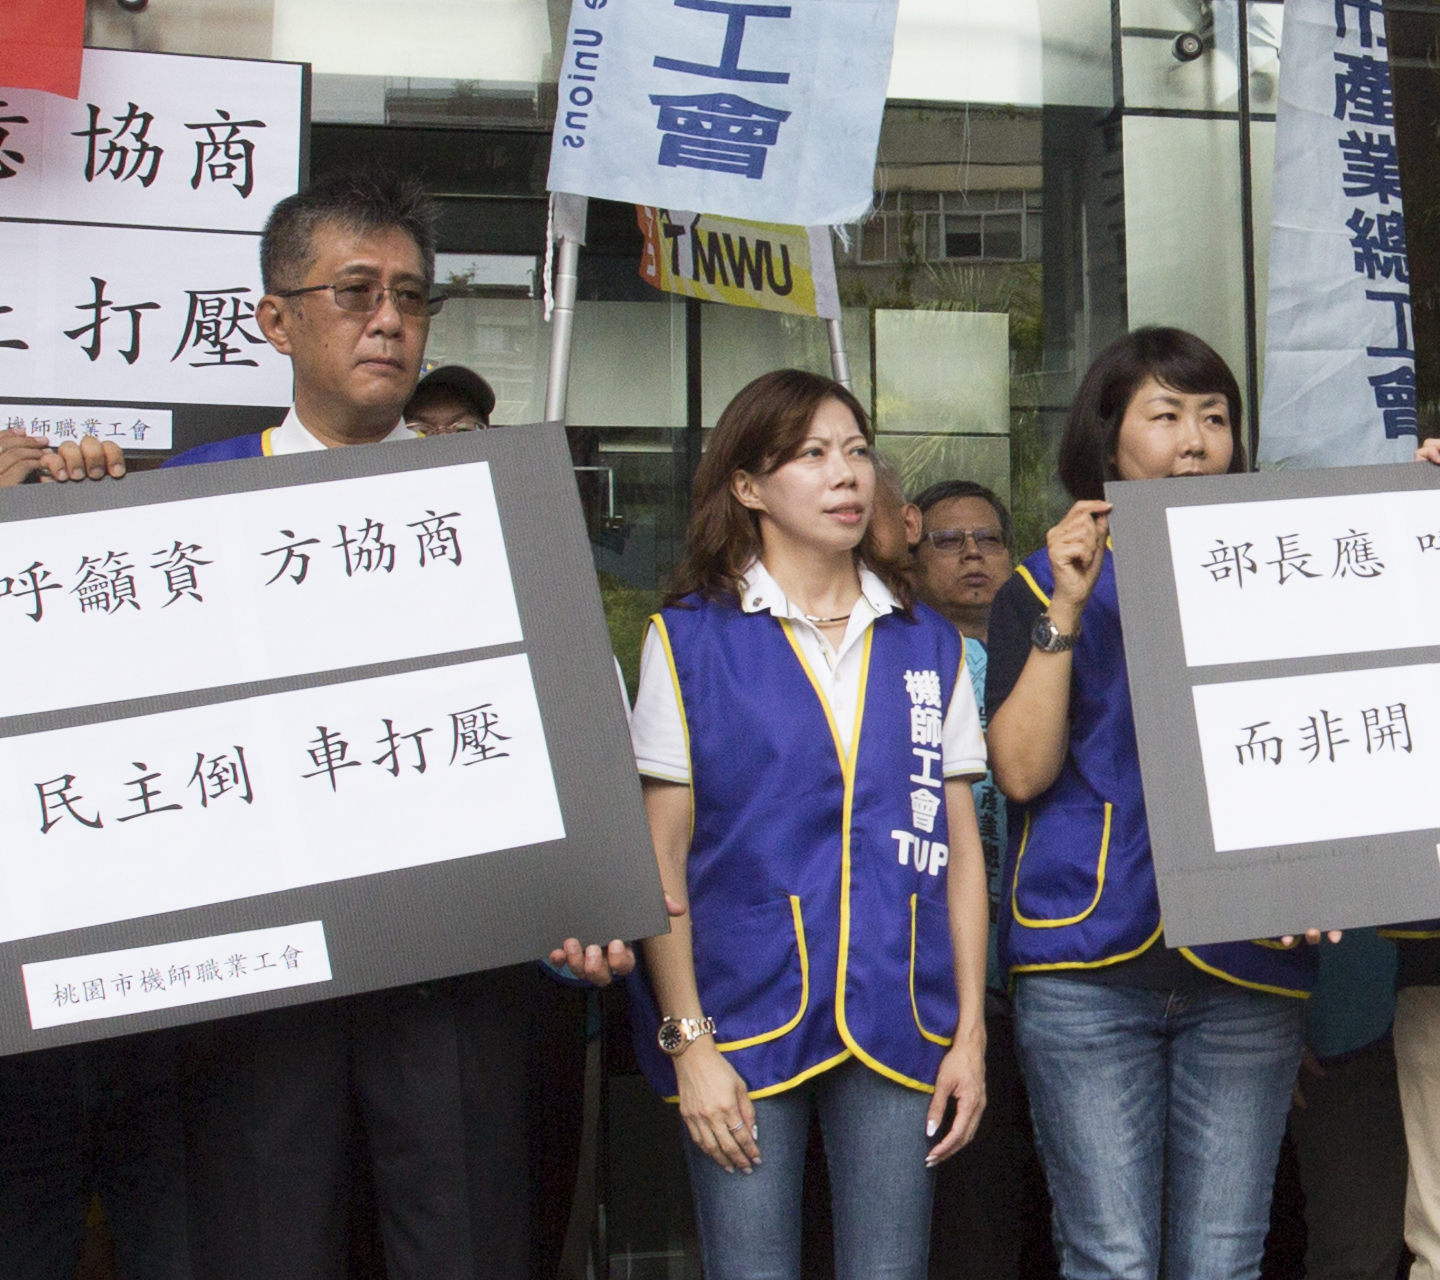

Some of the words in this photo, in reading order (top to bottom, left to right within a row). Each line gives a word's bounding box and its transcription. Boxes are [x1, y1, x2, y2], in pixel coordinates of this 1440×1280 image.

[662, 221, 794, 297] TMWU
[903, 670, 943, 834] 機師工會
[891, 829, 949, 877] TUP
[55, 950, 300, 1003] 桃園市機師職業工會
